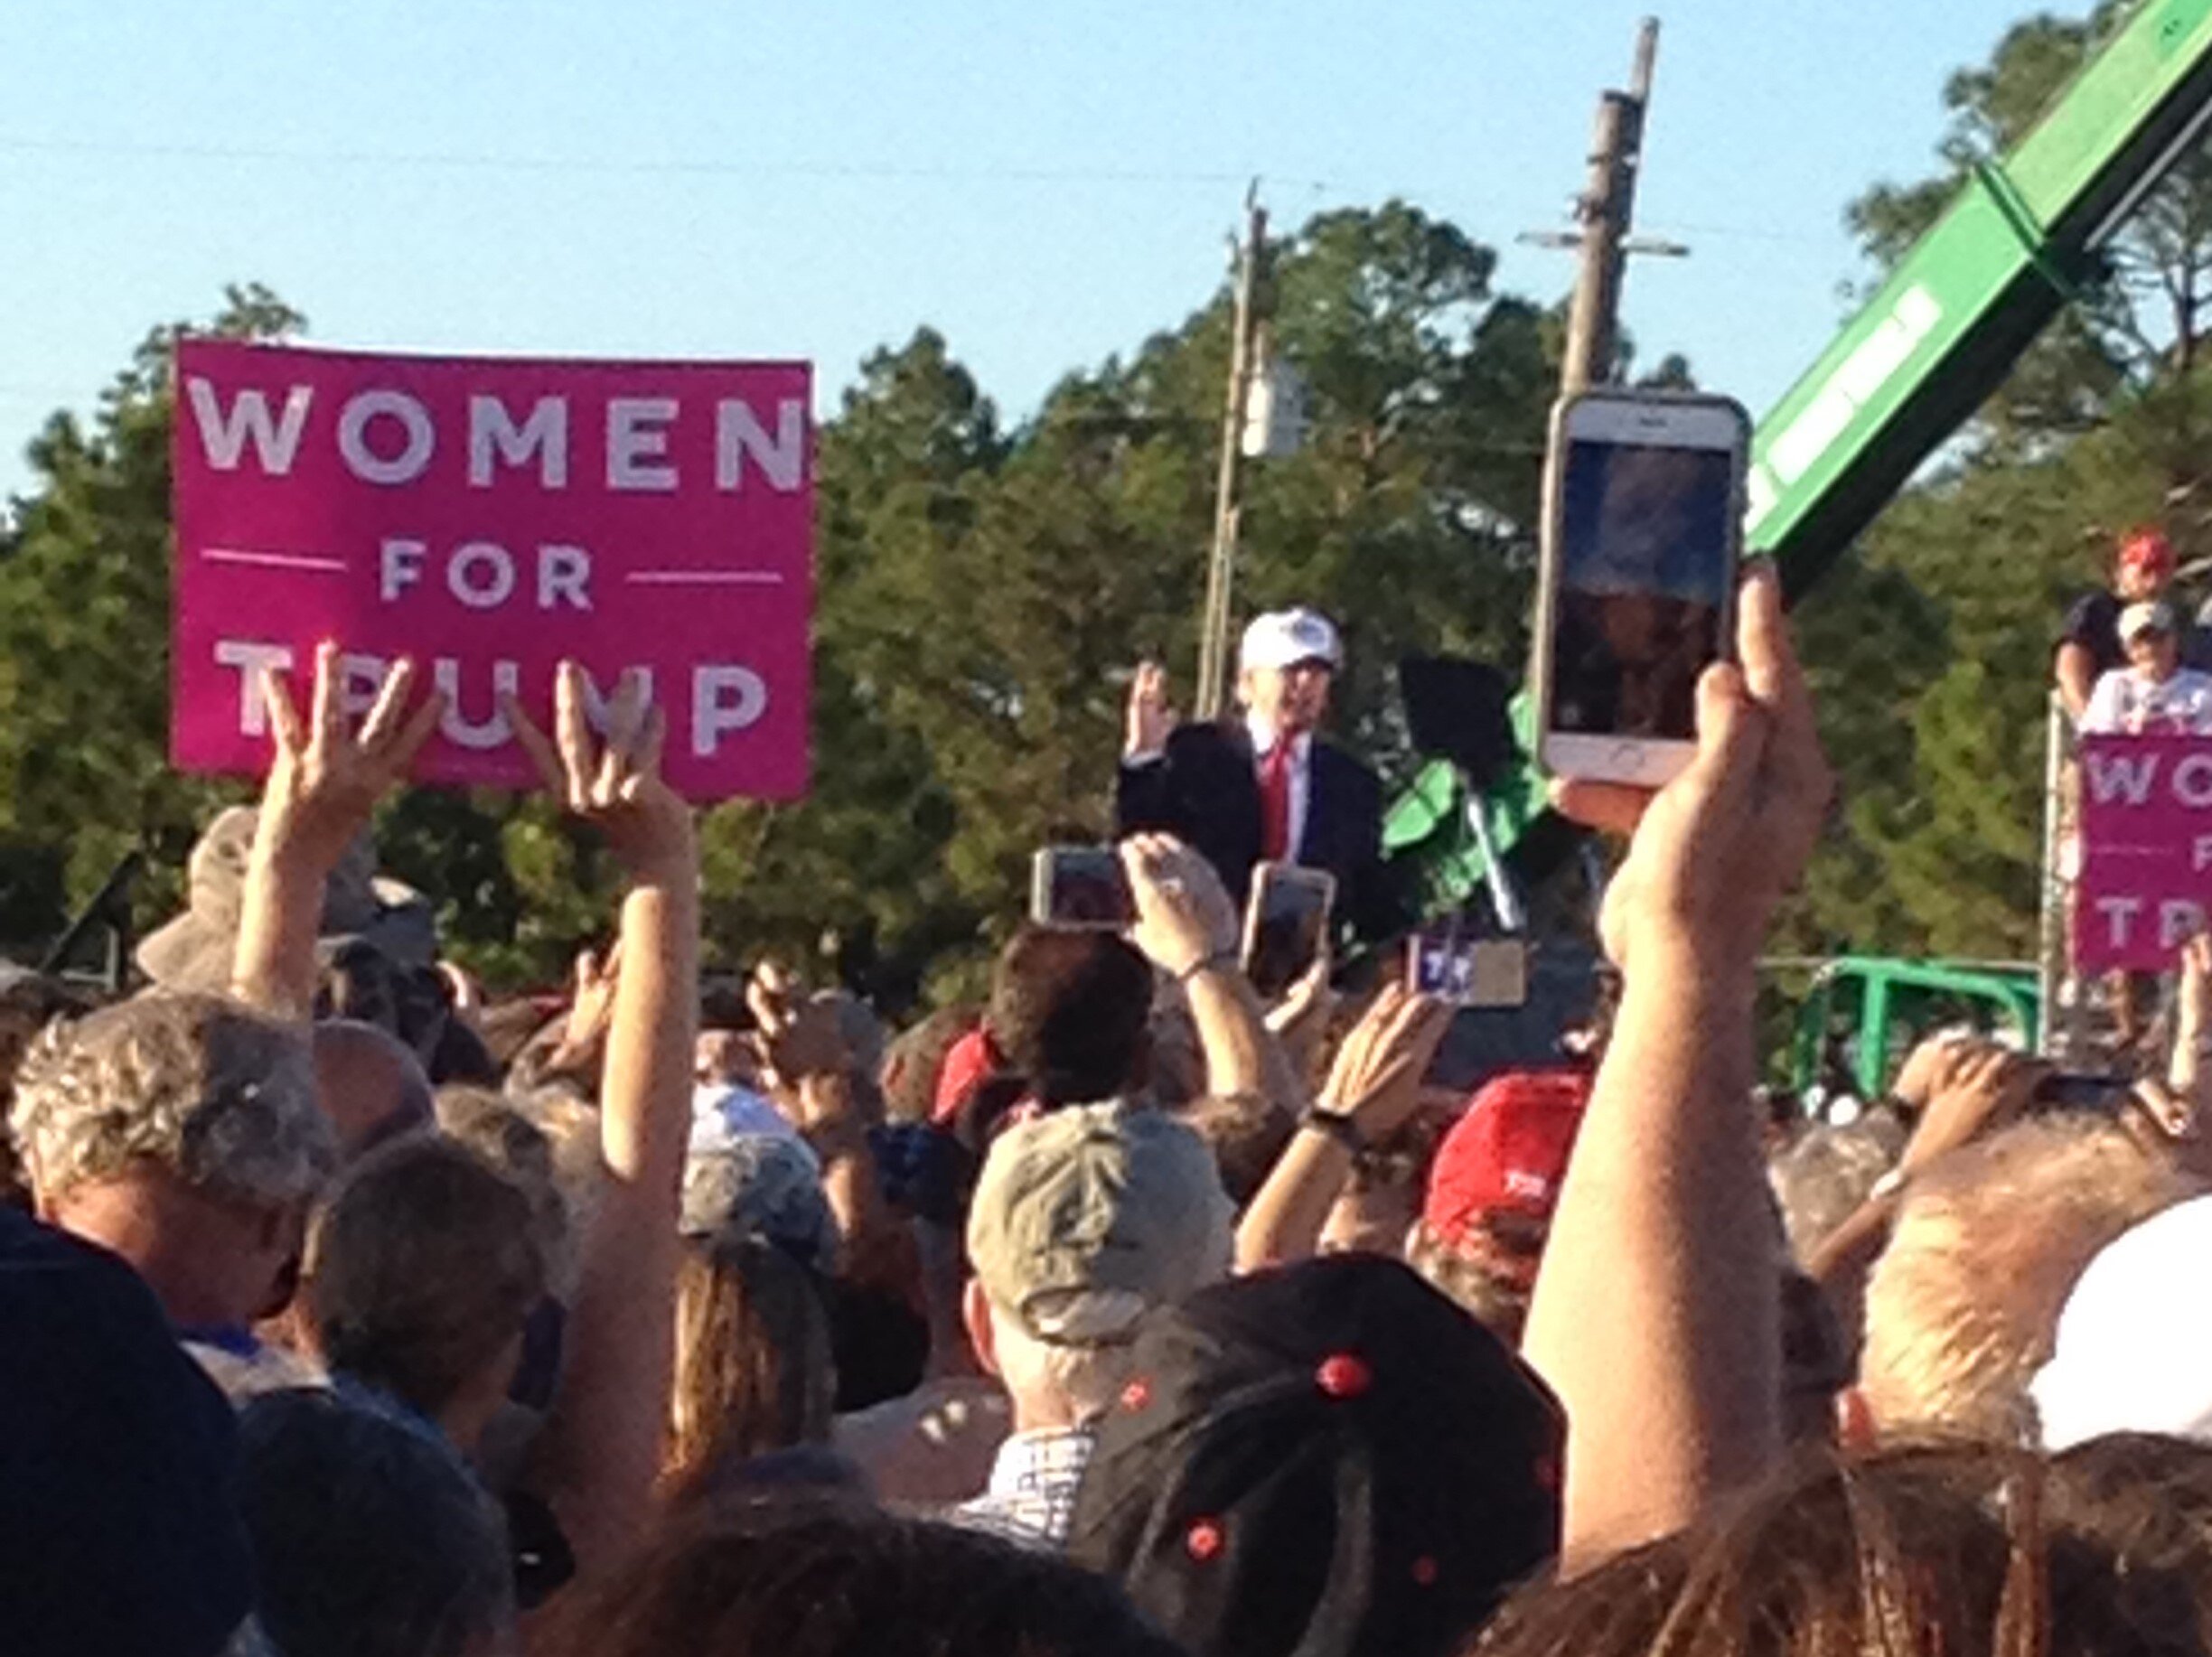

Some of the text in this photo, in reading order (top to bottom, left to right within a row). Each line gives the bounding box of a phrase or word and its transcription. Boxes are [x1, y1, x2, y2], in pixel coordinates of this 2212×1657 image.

[186, 377, 803, 491] WOMEN
[380, 539, 593, 610] FOR
[2085, 751, 2212, 807] WO
